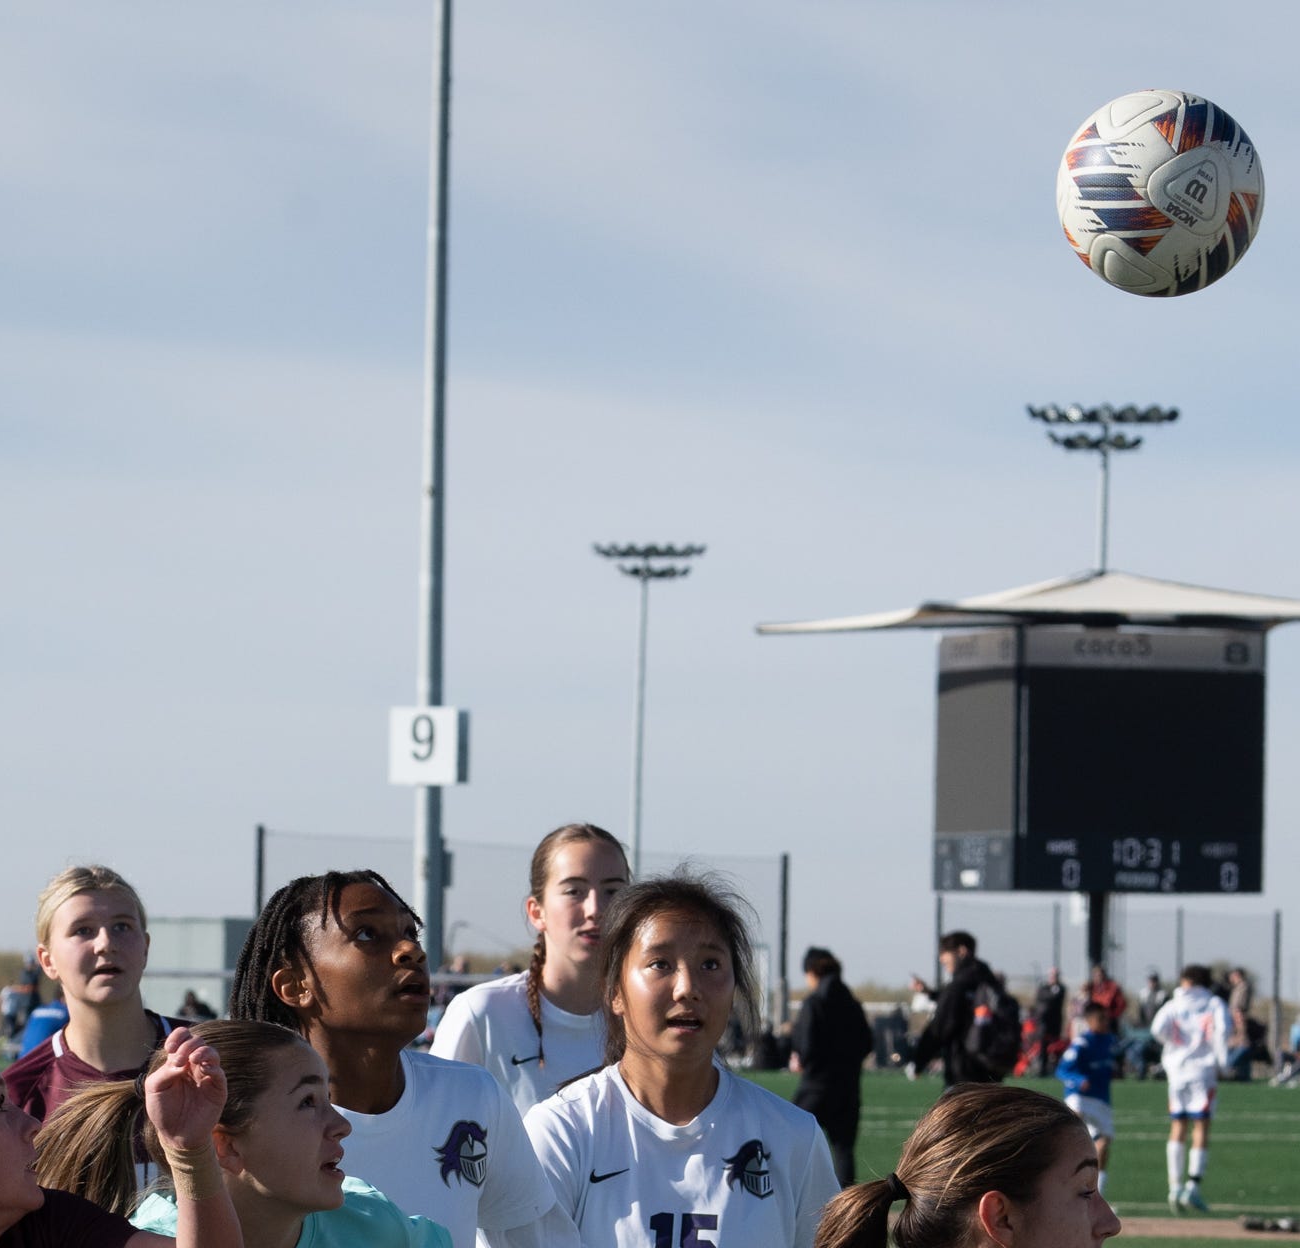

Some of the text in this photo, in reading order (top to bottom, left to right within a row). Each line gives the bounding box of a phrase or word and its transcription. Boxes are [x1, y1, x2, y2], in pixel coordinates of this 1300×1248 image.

[1166, 201, 1198, 228] NCAA
[412, 714, 434, 761] 9
[1061, 858, 1081, 889] 0
[1220, 861, 1239, 892] 0
